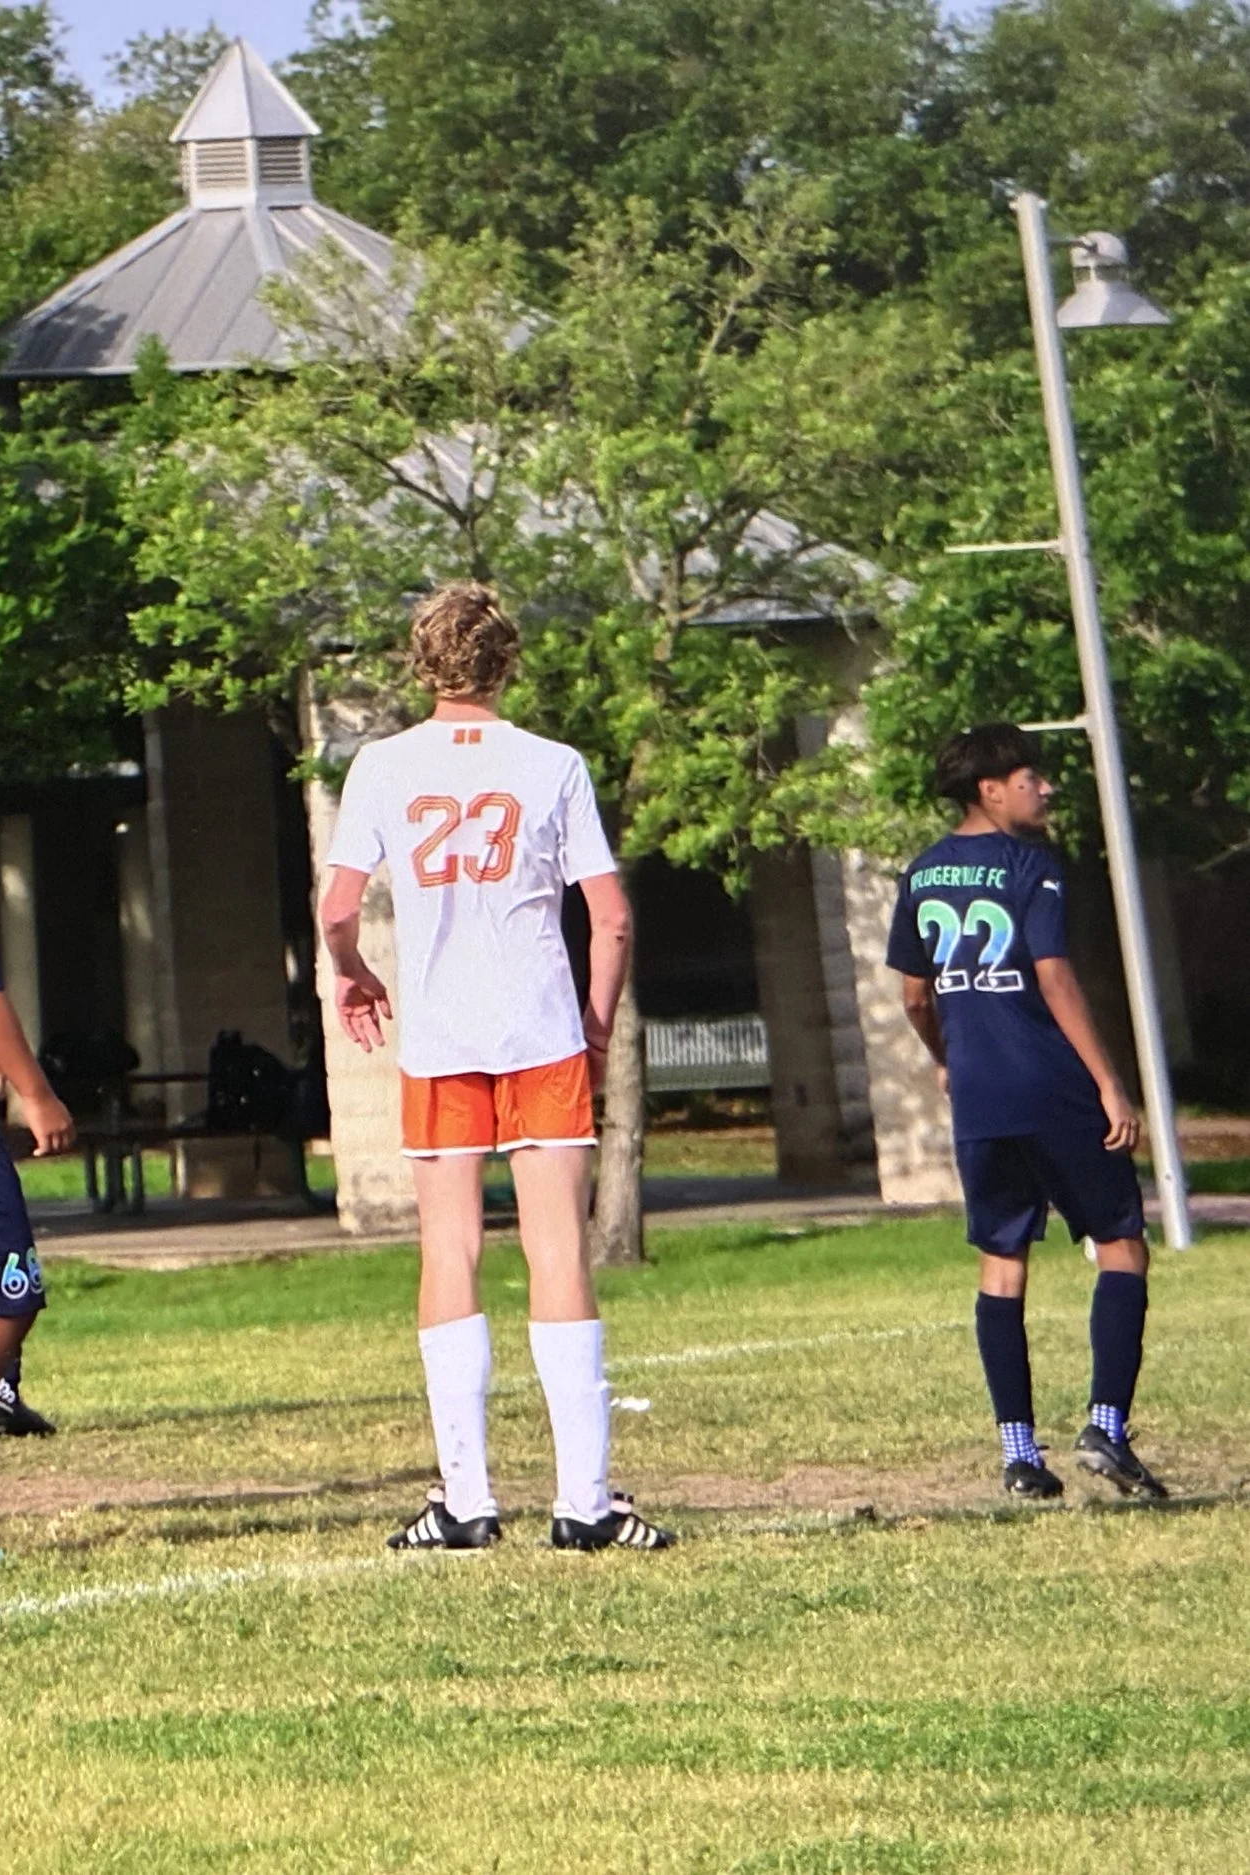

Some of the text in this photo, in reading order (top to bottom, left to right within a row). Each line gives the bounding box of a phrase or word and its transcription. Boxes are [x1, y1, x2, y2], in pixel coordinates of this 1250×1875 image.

[407, 793, 522, 887] 23
[986, 867, 1007, 889] FC
[917, 900, 1024, 994] 22
[1, 1247, 44, 1299] 68
